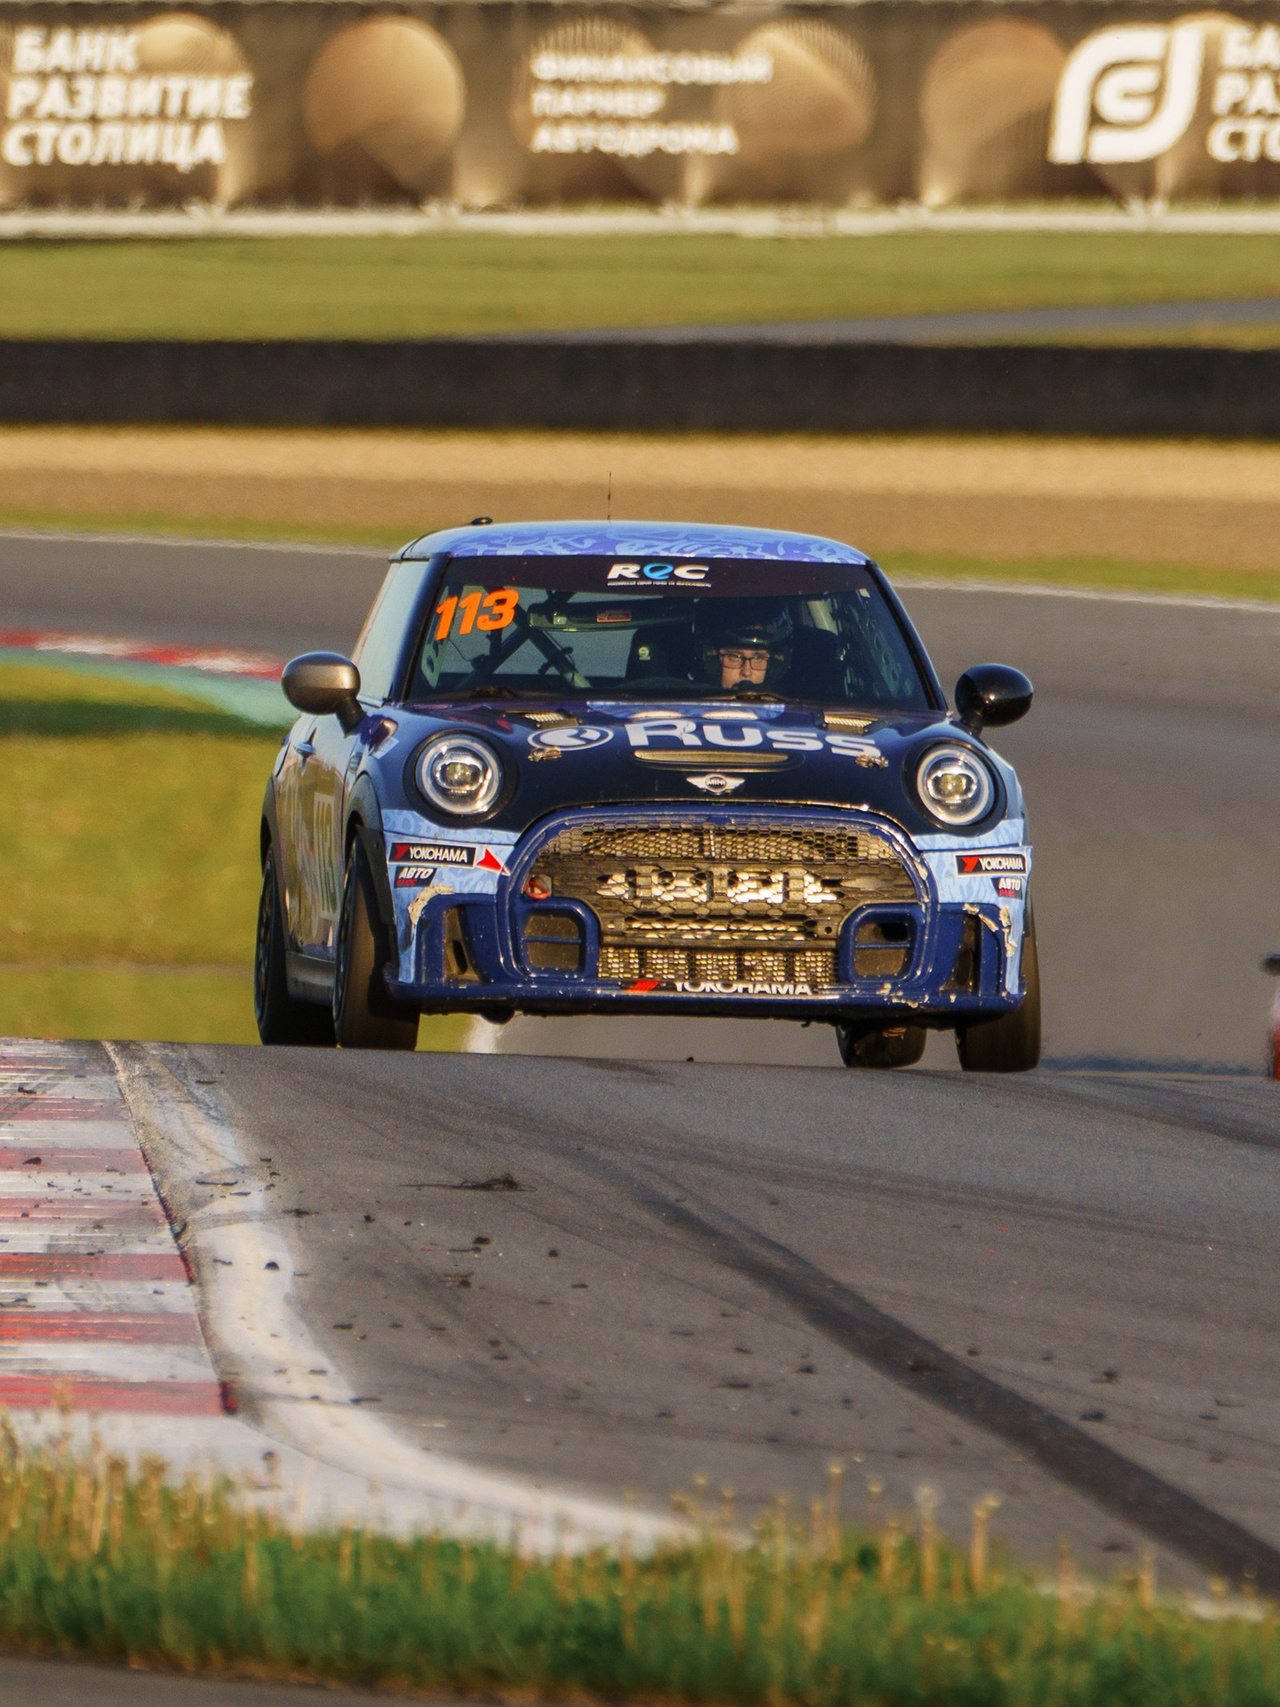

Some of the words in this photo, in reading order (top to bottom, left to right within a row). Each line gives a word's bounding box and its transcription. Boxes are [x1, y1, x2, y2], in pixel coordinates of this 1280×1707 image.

[13, 25, 139, 73] БАНК
[6, 73, 252, 119] РАЗВИТИЕ
[3, 120, 227, 174] СТОЛИЦА
[531, 121, 741, 158] АВТОДРОМА
[435, 588, 519, 641] 113
[398, 866, 435, 880] АВТО
[408, 846, 469, 863] YOKOHAMA
[978, 856, 1024, 871] YOKOHAMA
[674, 981, 813, 996] YOKOHAMA
